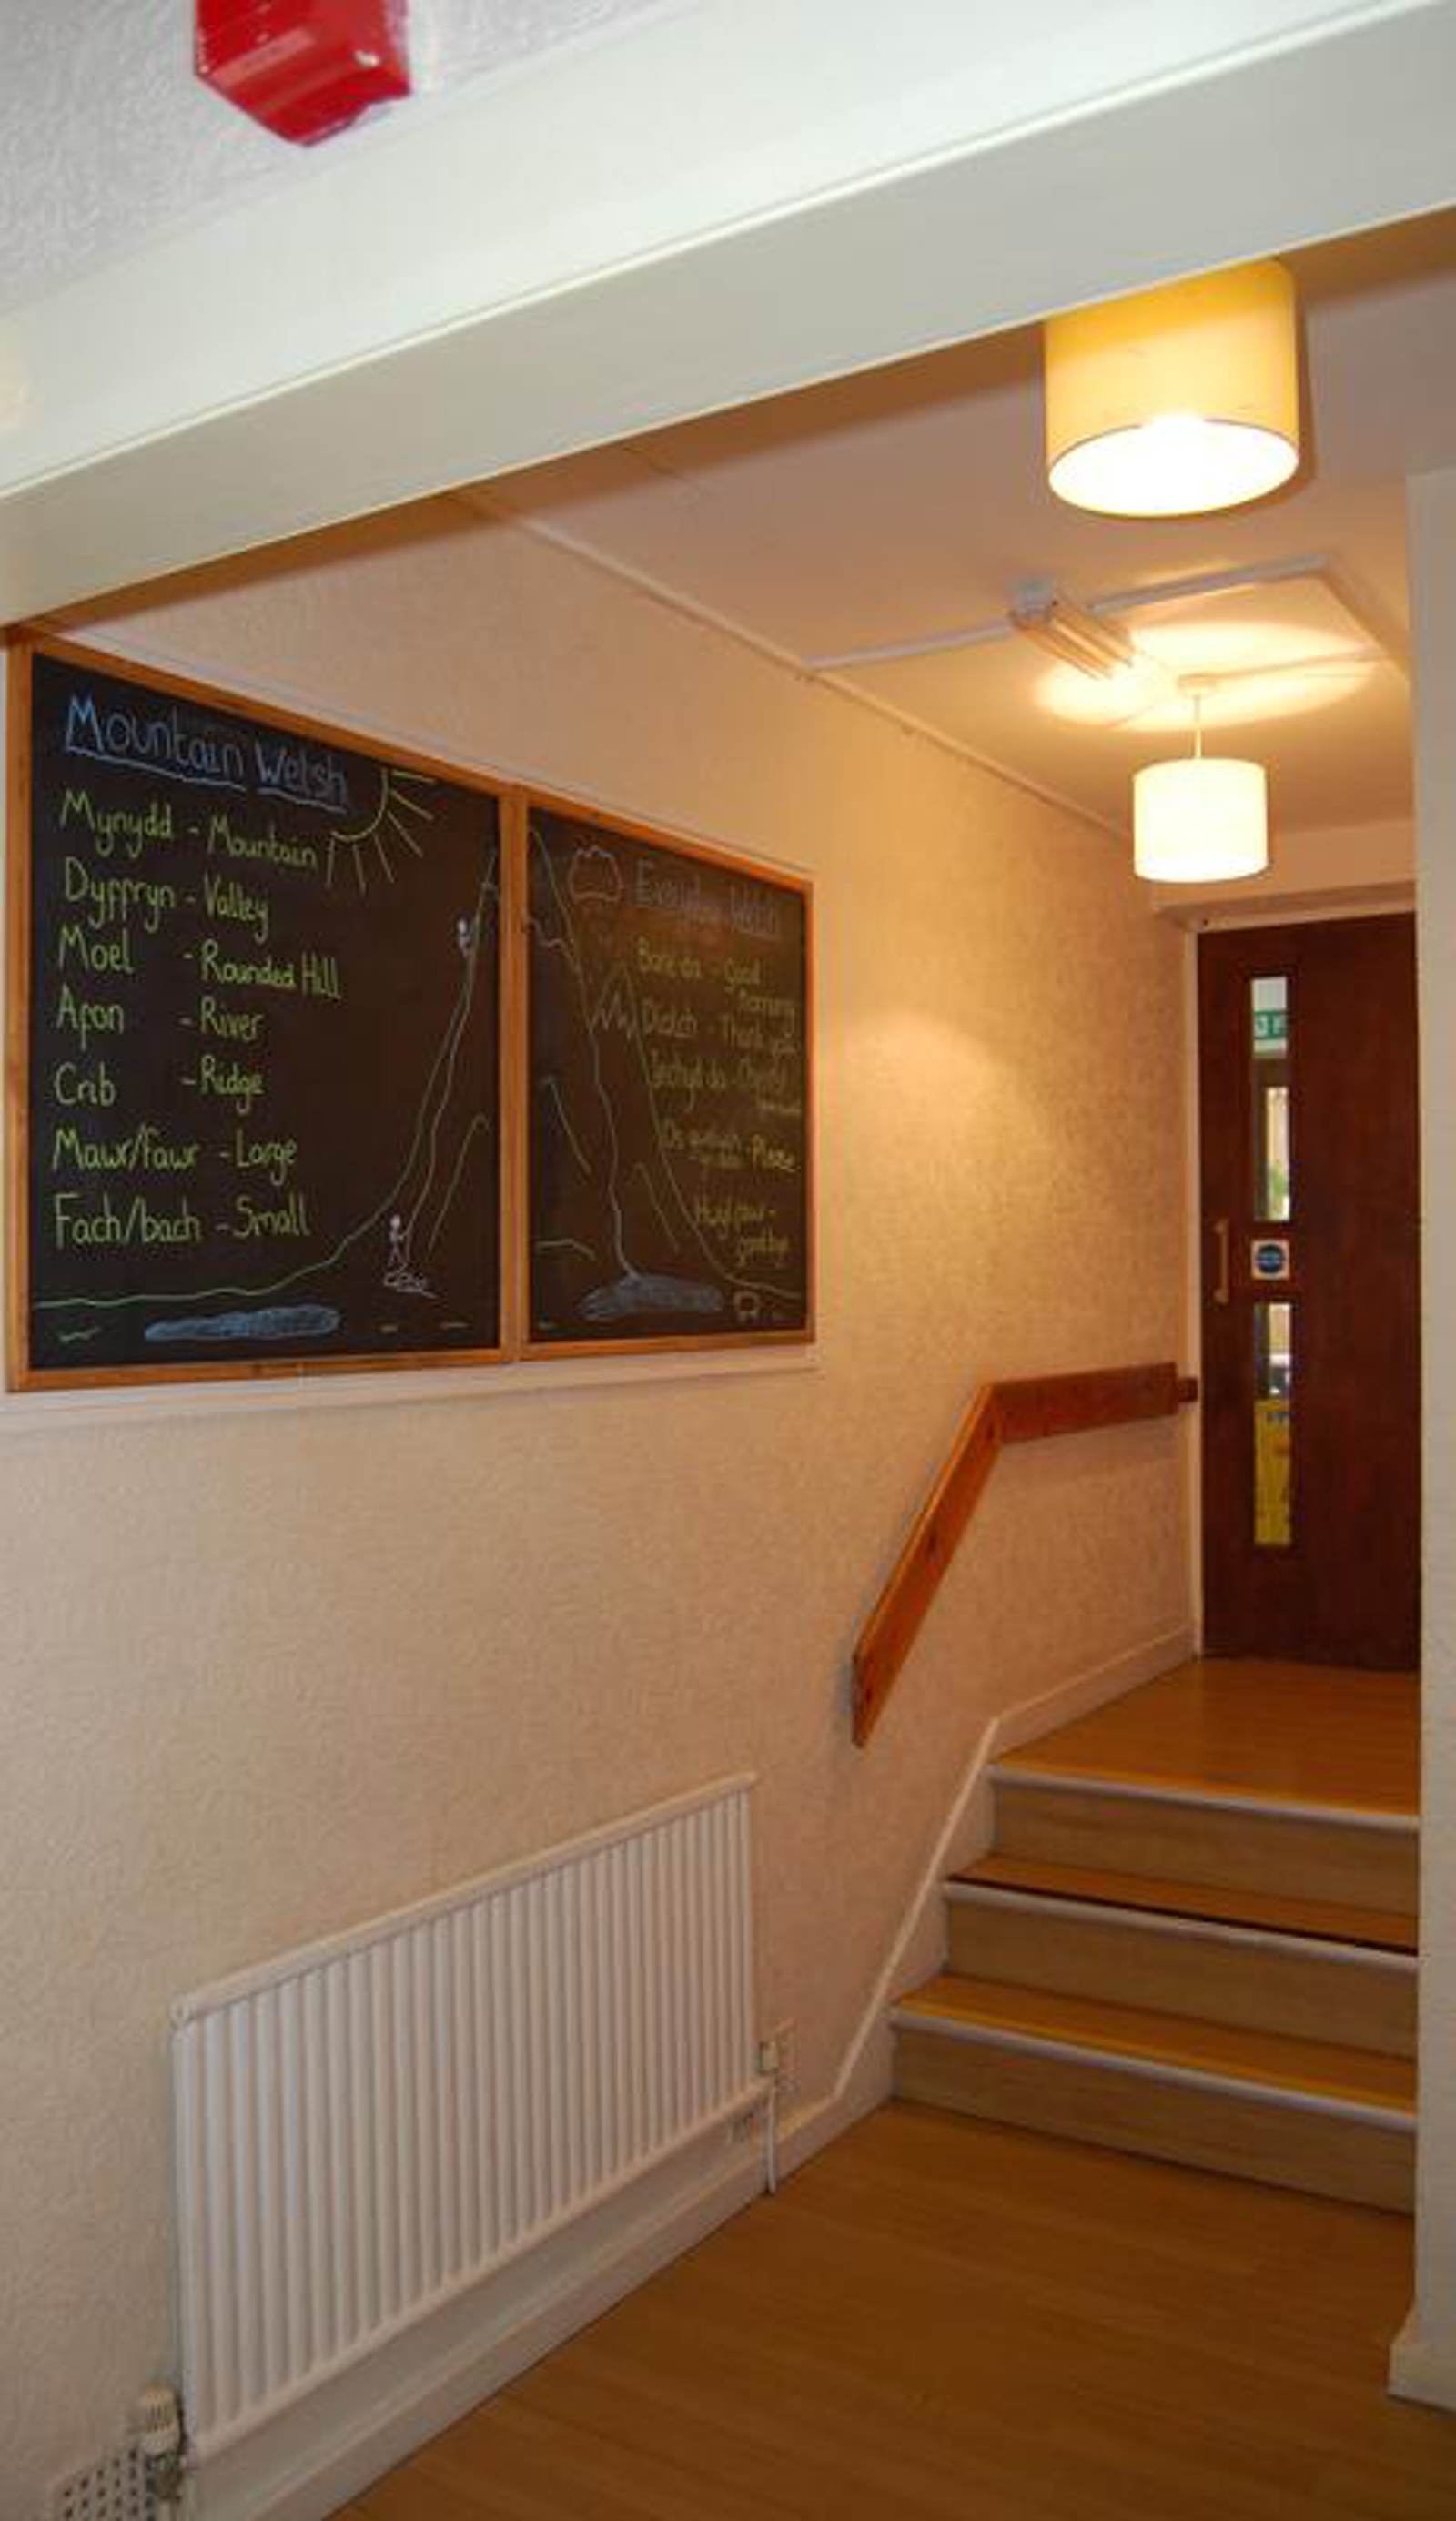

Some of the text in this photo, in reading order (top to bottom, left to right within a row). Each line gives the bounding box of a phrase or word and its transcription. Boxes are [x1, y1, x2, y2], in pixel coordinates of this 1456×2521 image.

[66, 694, 349, 805] Mountain Welsh
[58, 789, 173, 858] Mynydd
[207, 816, 318, 868] Mountain
[204, 873, 268, 942] Valley
[57, 926, 135, 973] Moel
[201, 939, 297, 987] Rounded
[301, 952, 341, 1000] Hill
[200, 996, 263, 1042] River
[201, 1054, 264, 1115] Ridge
[235, 1129, 297, 1186] Large
[55, 1193, 201, 1250] Fach/bach
[233, 1191, 310, 1239] Small
